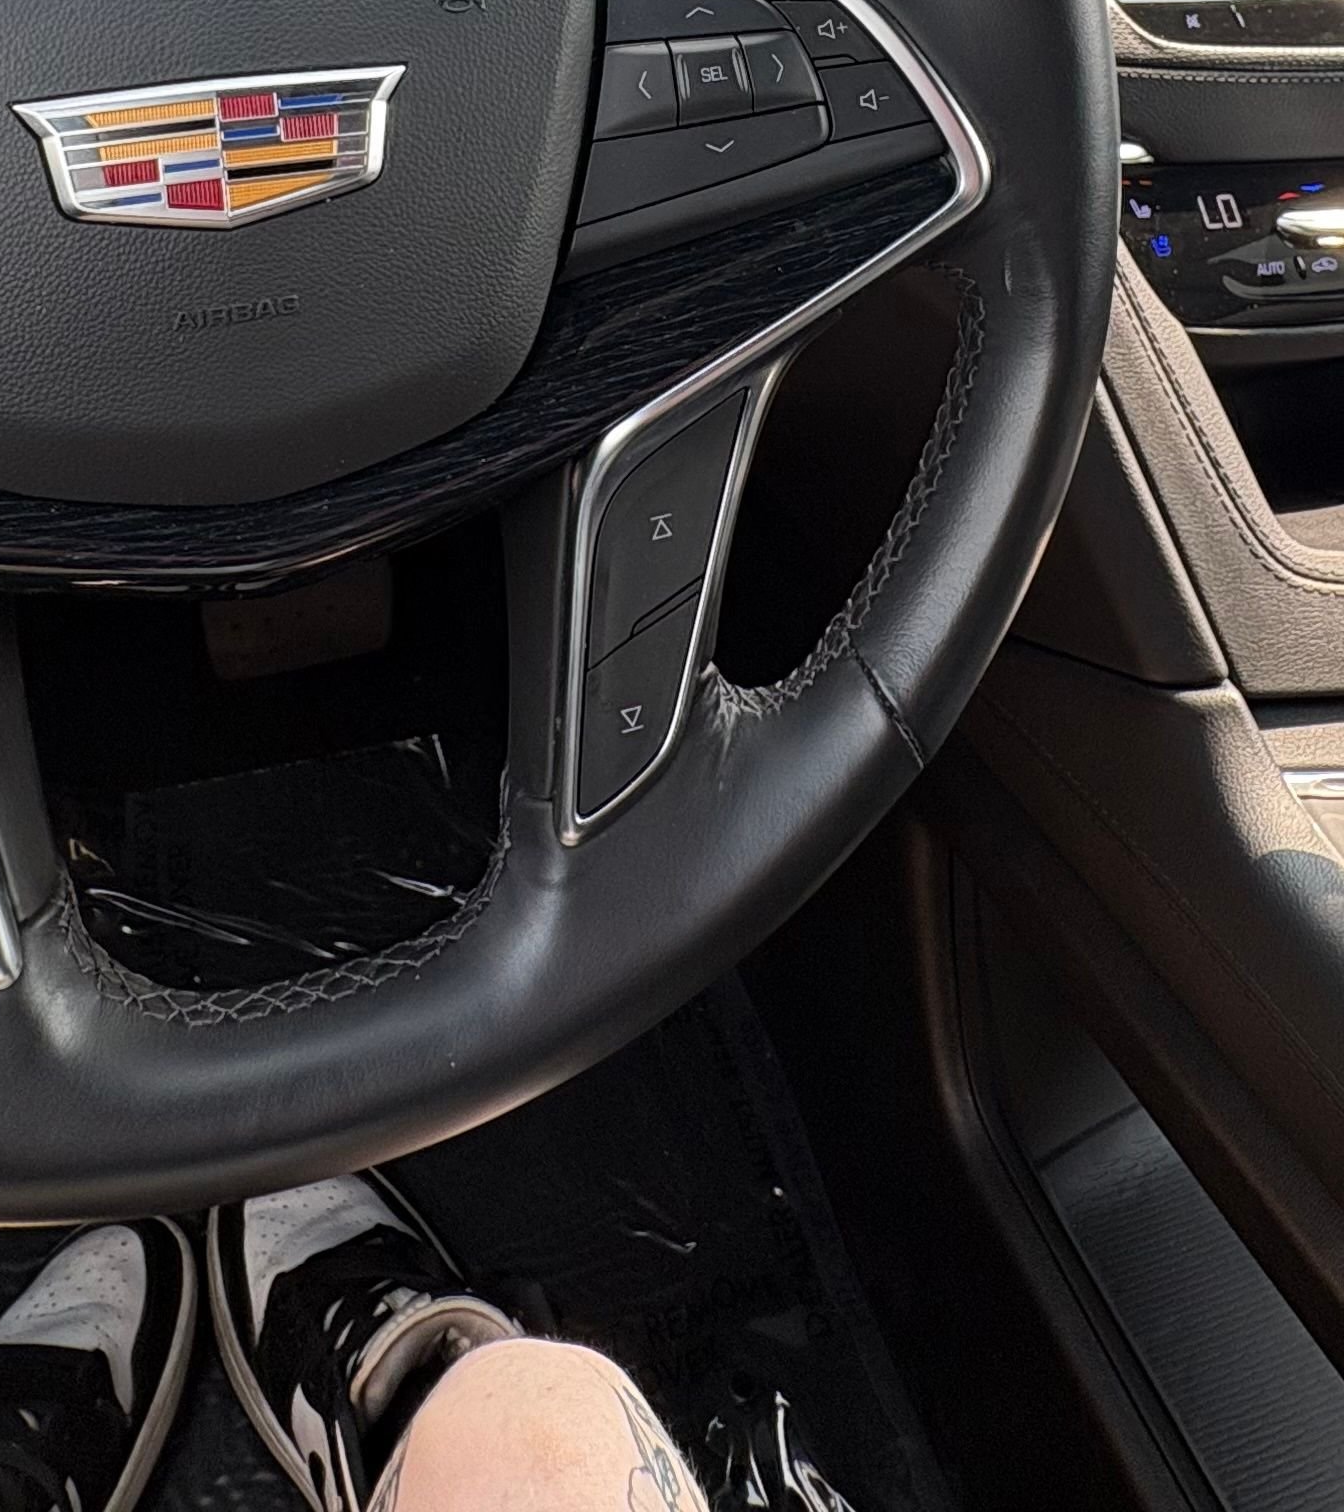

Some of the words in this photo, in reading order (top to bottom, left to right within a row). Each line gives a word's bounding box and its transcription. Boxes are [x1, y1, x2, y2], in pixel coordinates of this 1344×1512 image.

[701, 66, 729, 83] SEL
[1197, 193, 1243, 230] LO
[1257, 261, 1285, 276] AUTO
[172, 294, 301, 332] AIRBAG
